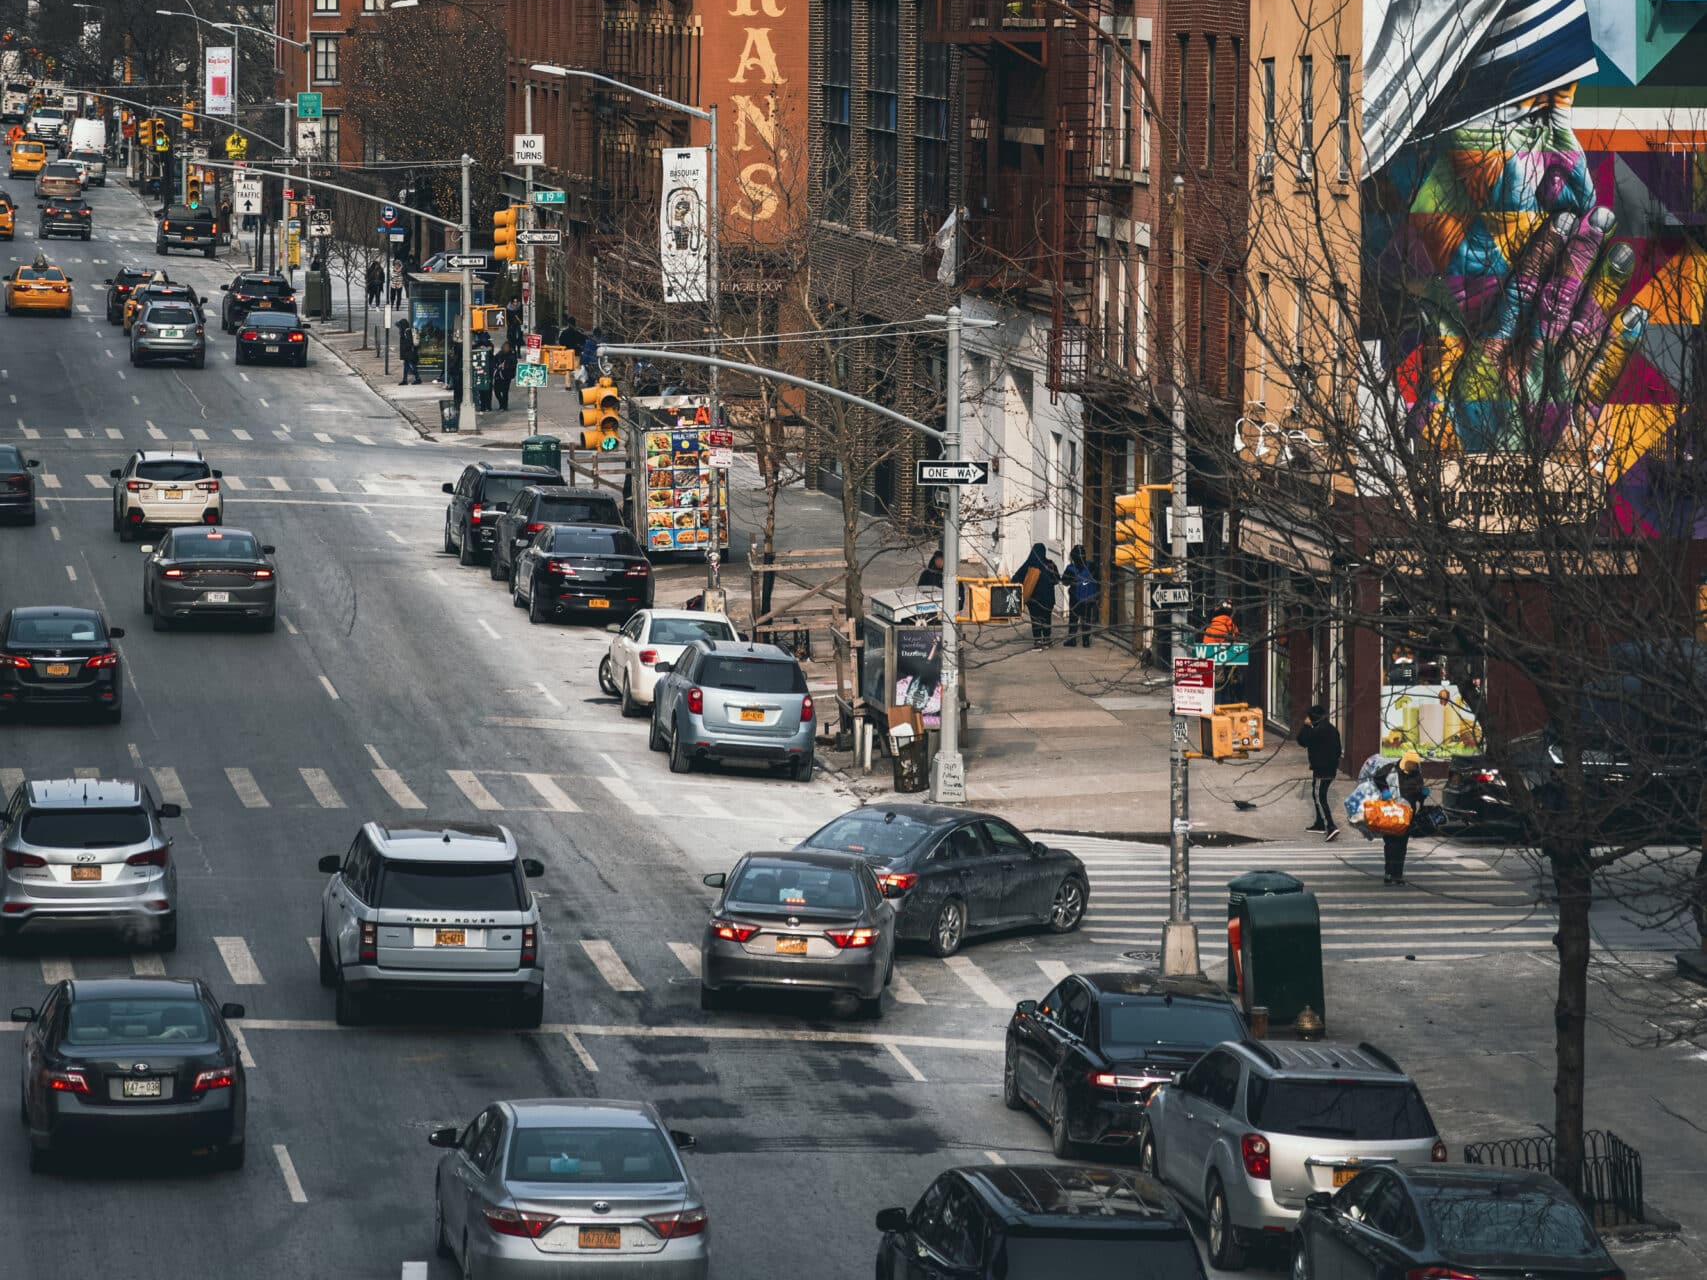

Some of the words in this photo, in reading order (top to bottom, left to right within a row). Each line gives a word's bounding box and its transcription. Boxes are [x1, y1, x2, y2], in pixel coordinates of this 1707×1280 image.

[522, 139, 536, 149] NO
[516, 151, 543, 160] TURNS
[677, 152, 691, 160] NYC
[669, 169, 699, 177] BASQUIAT
[237, 191, 261, 199] TRAFFIC
[536, 193, 544, 201] W
[546, 192, 555, 201] 19
[928, 468, 949, 478] ONE
[957, 467, 978, 478] WAY
[1155, 590, 1169, 602] ONE
[1172, 590, 1187, 601] WAY
[1195, 646, 1208, 658] W
[1213, 646, 1228, 662] 18
[1233, 646, 1244, 654] ST
